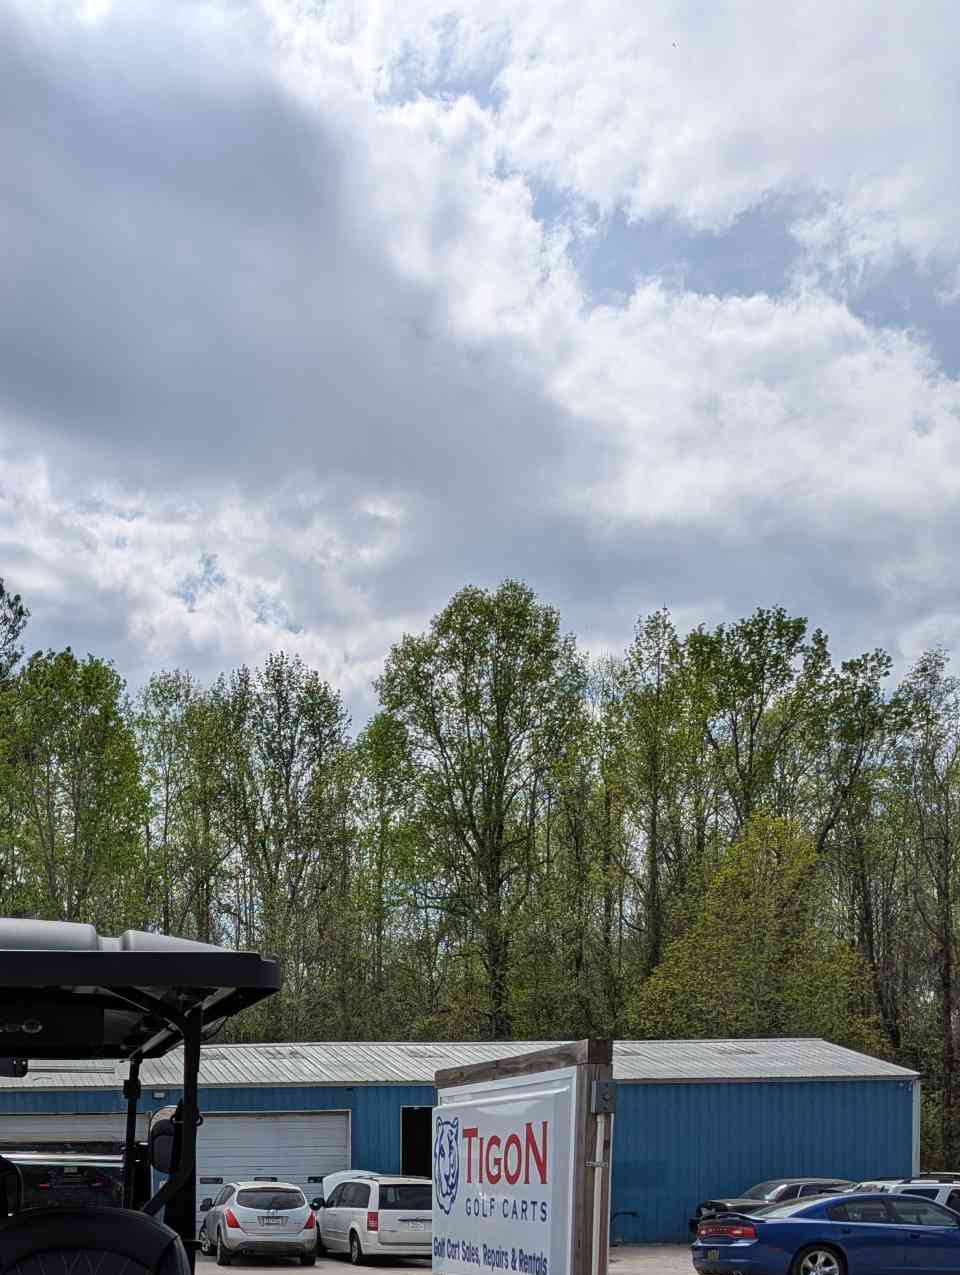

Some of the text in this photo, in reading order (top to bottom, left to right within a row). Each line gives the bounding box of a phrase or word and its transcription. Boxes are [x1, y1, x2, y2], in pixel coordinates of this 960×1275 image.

[462, 1120, 548, 1185] TIGON
[465, 1198, 548, 1222] GOLF CARTS
[433, 1236, 446, 1258] Golf
[446, 1238, 461, 1261] Cart
[461, 1240, 481, 1267] Sales,
[482, 1243, 509, 1272] Repairs
[510, 1247, 518, 1271] &
